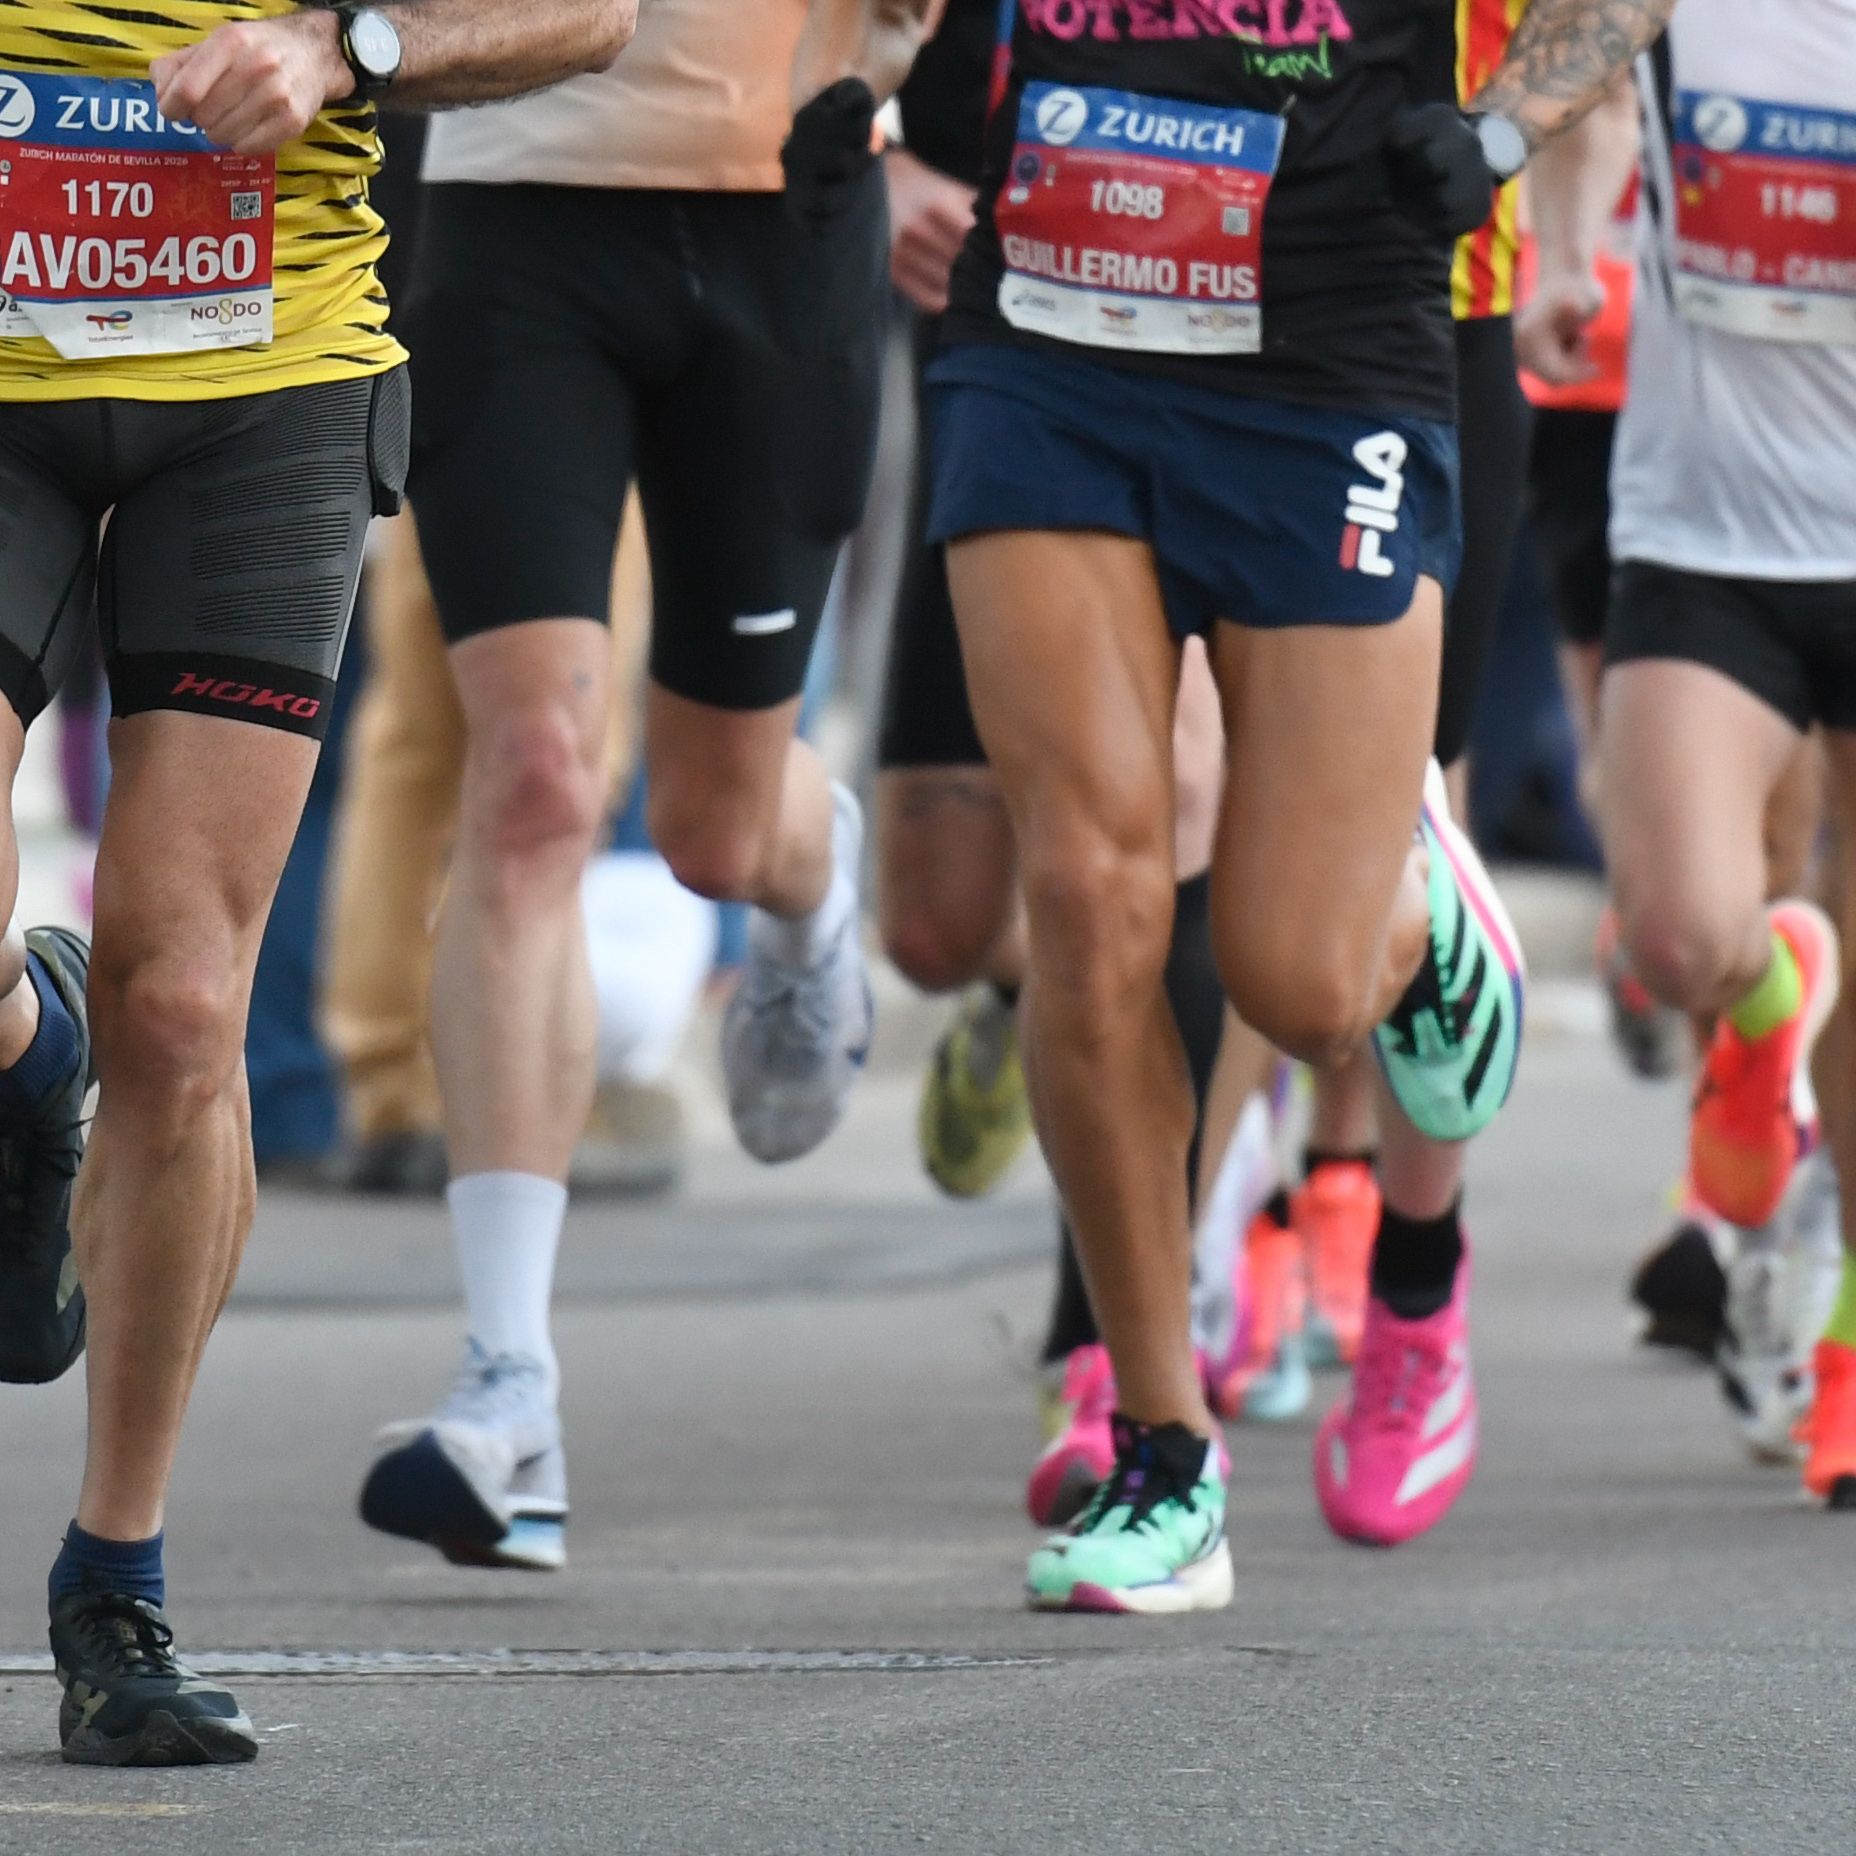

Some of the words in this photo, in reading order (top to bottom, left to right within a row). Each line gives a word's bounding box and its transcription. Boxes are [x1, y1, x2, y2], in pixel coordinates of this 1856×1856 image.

[56, 95, 204, 134] ZURI
[1098, 105, 1244, 156] ZURICH
[19, 147, 53, 160] ZURICH
[55, 150, 106, 164] MARATÓN
[108, 154, 121, 165] DE
[124, 155, 162, 166] SEVILLA
[61, 178, 155, 218] 1170
[1091, 180, 1164, 220] 1098
[1003, 235, 1178, 293] GUILLERMO
[1188, 261, 1256, 299] FUS
[1339, 430, 1408, 578] FILA
